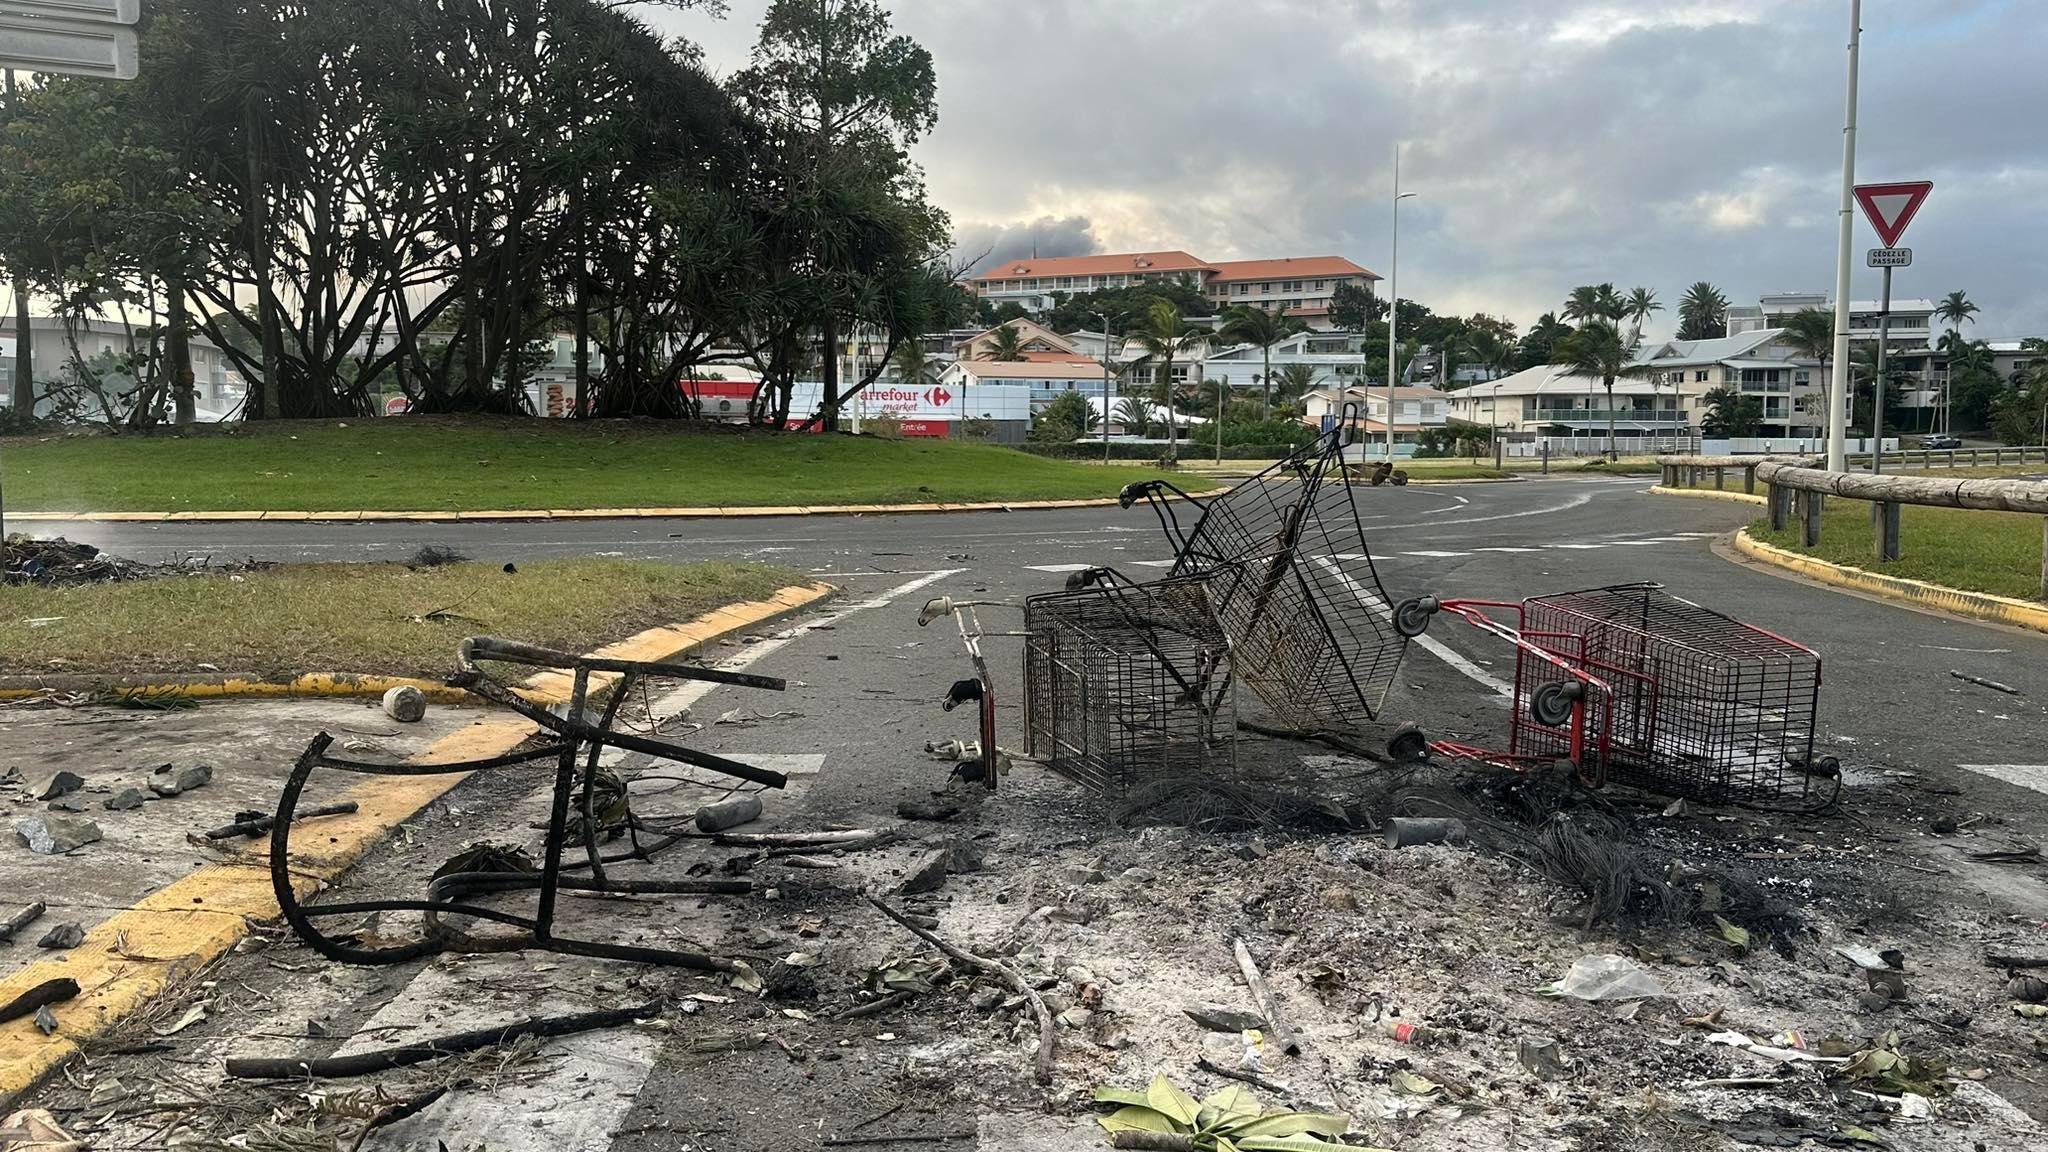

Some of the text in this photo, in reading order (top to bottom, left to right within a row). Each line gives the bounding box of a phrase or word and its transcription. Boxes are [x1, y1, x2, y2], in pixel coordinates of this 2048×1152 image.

[1872, 257, 1906, 265] PASSAGE
[859, 387, 919, 401] arrefour
[881, 402, 918, 412] market
